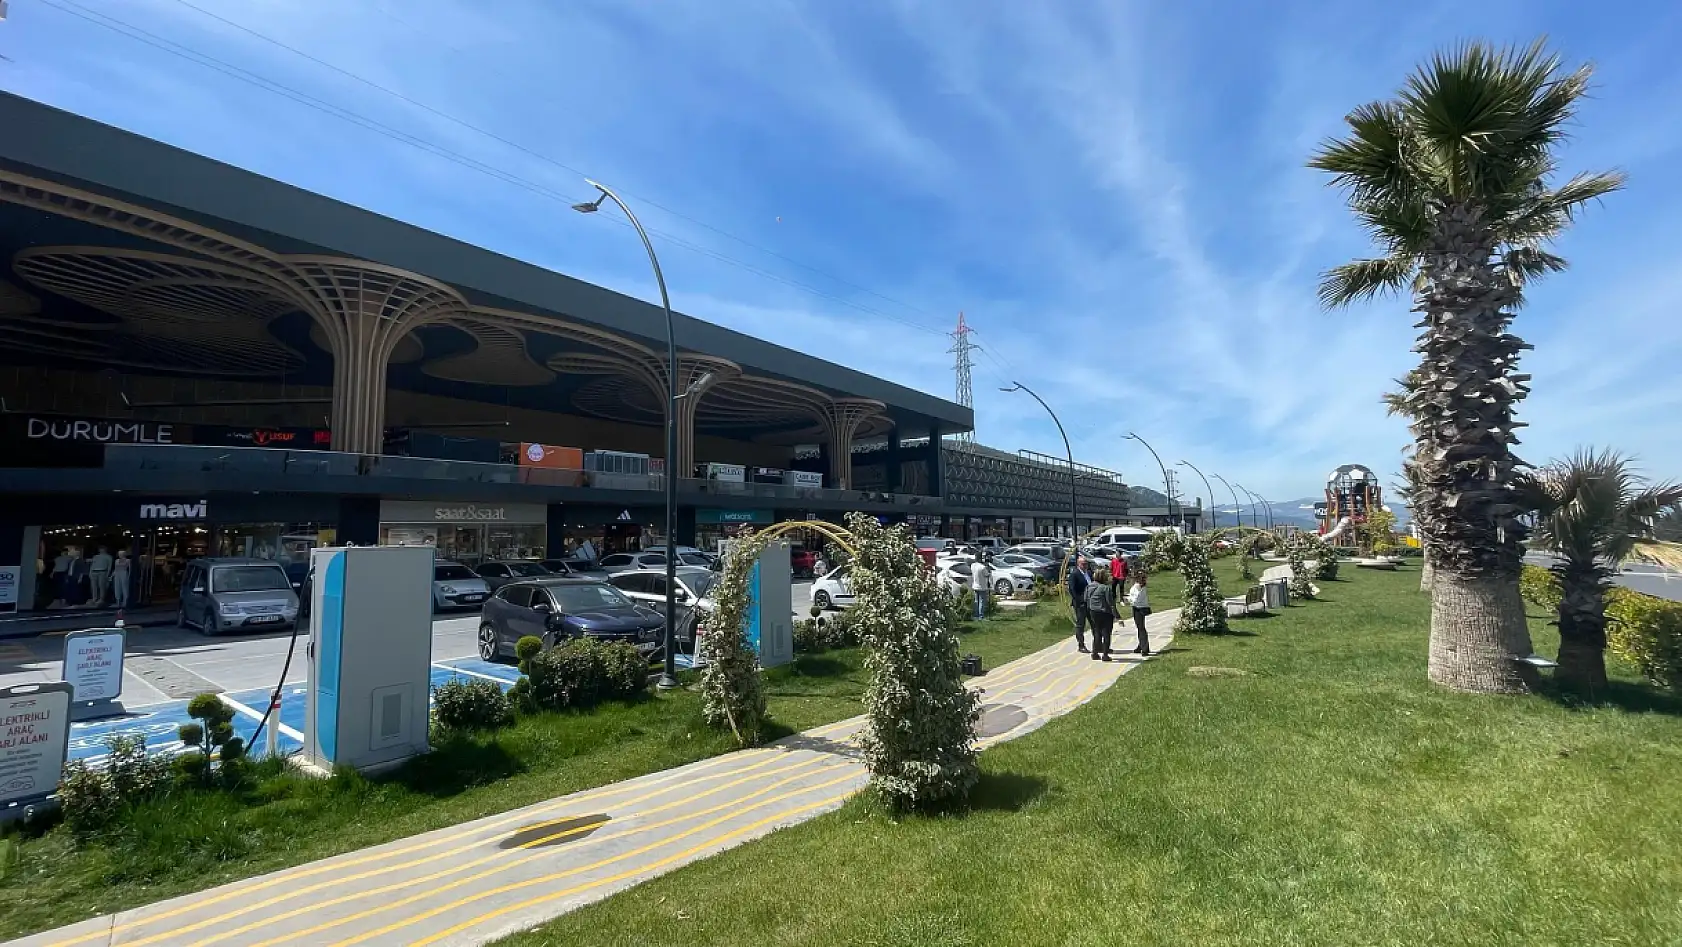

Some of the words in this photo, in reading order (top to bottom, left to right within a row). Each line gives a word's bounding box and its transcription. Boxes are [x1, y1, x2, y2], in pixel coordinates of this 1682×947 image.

[27, 417, 173, 444] DÜRÜMLE
[140, 500, 207, 519] mavi
[434, 504, 507, 520] saat&saat
[0, 709, 51, 727] LEKTRİKLİ
[19, 732, 48, 746] ALANI
